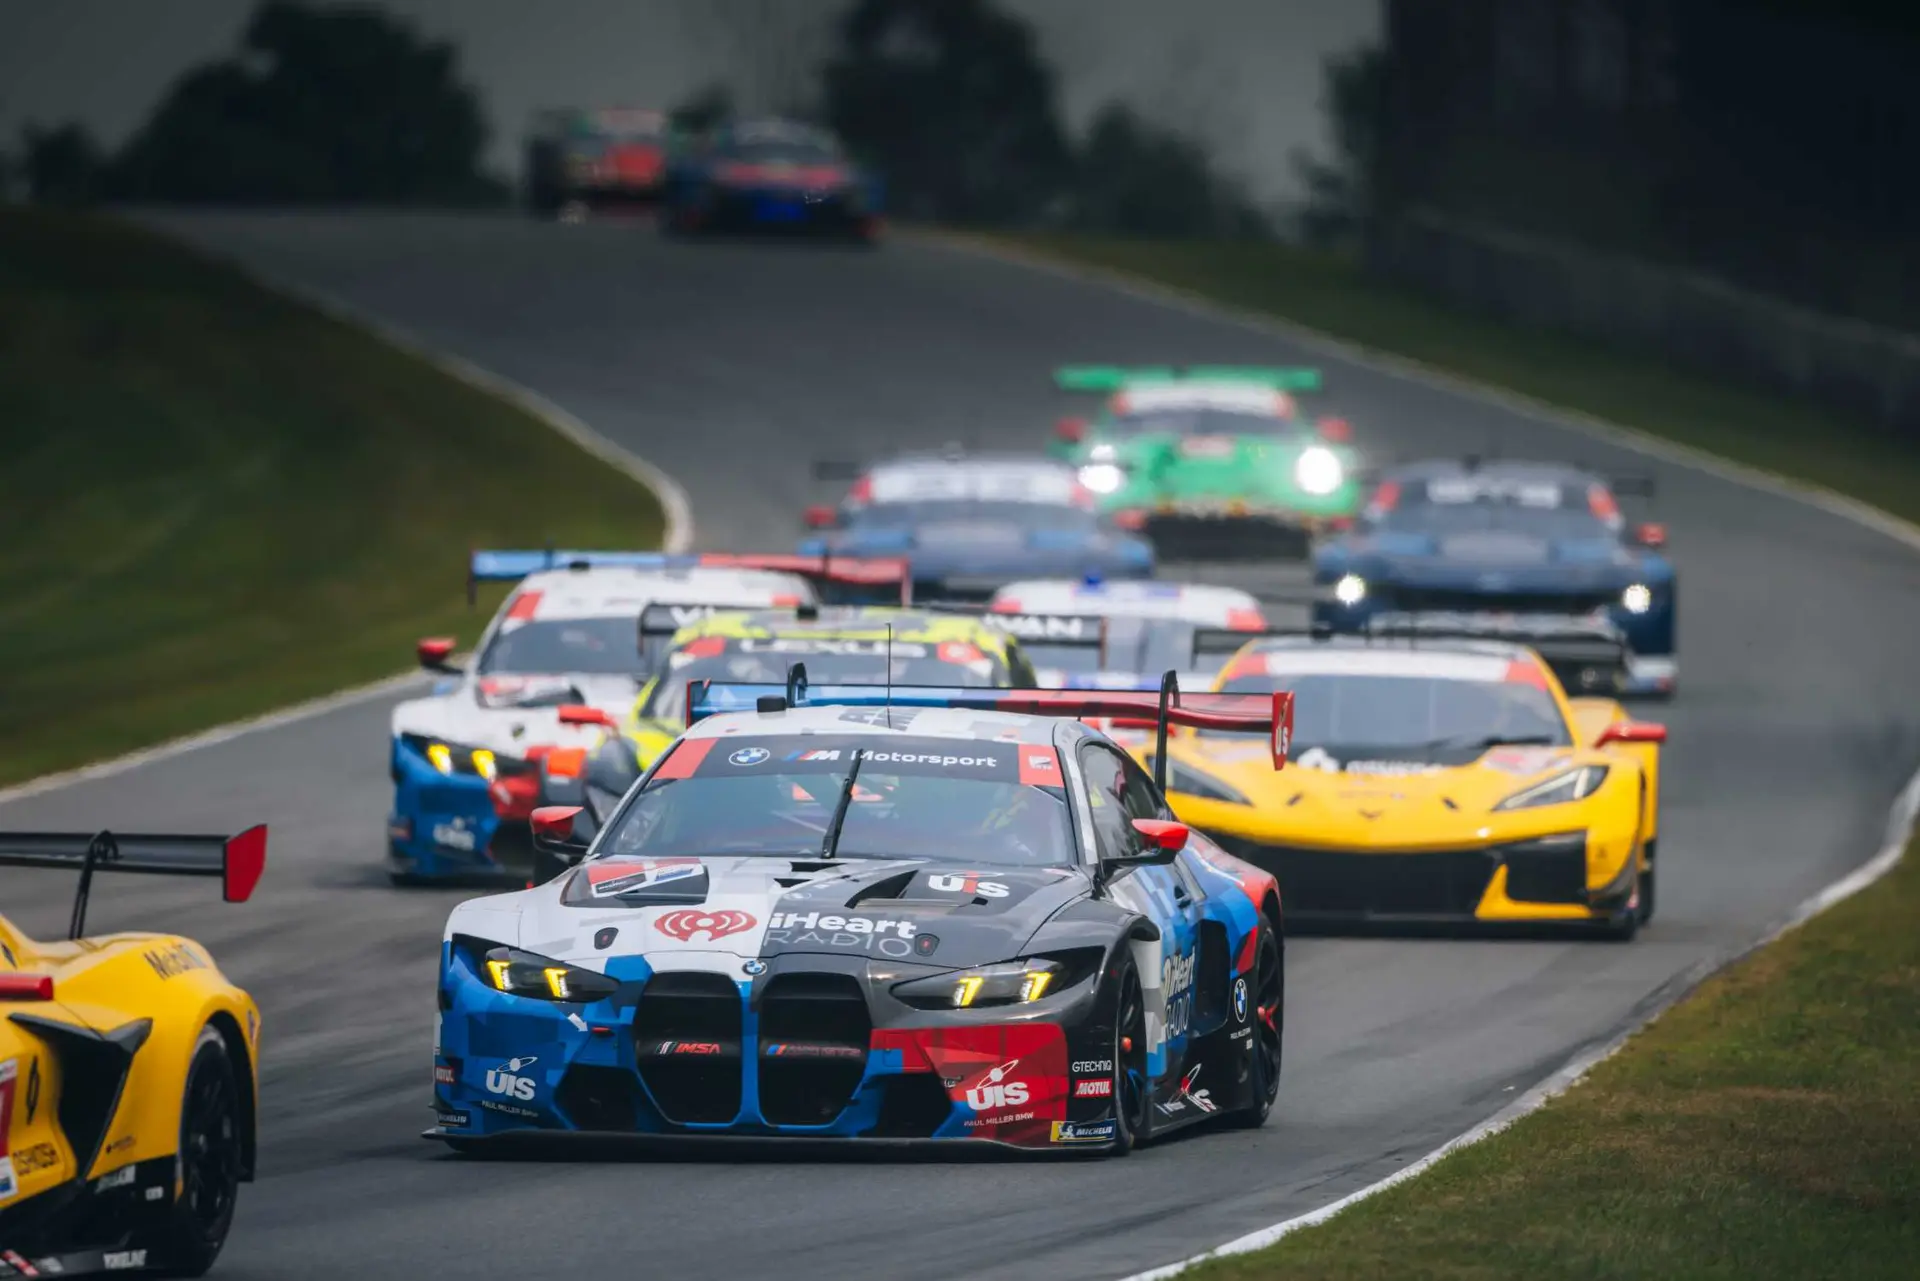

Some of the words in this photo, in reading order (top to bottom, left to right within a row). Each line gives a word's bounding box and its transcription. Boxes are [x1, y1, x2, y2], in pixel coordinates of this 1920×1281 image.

[850, 749, 997, 767] Motorsport
[768, 911, 917, 939] iHeart
[763, 930, 912, 957] RADIO
[675, 1043, 721, 1054] IMSA
[486, 1069, 536, 1101] UIS
[1076, 1081, 1111, 1095] MOTUL
[965, 1082, 1030, 1110] UIS
[964, 1119, 985, 1127] PAUL
[986, 1114, 1014, 1125] MILLER
[1015, 1112, 1034, 1121] BMW
[1076, 1126, 1113, 1136] MICHELIN
